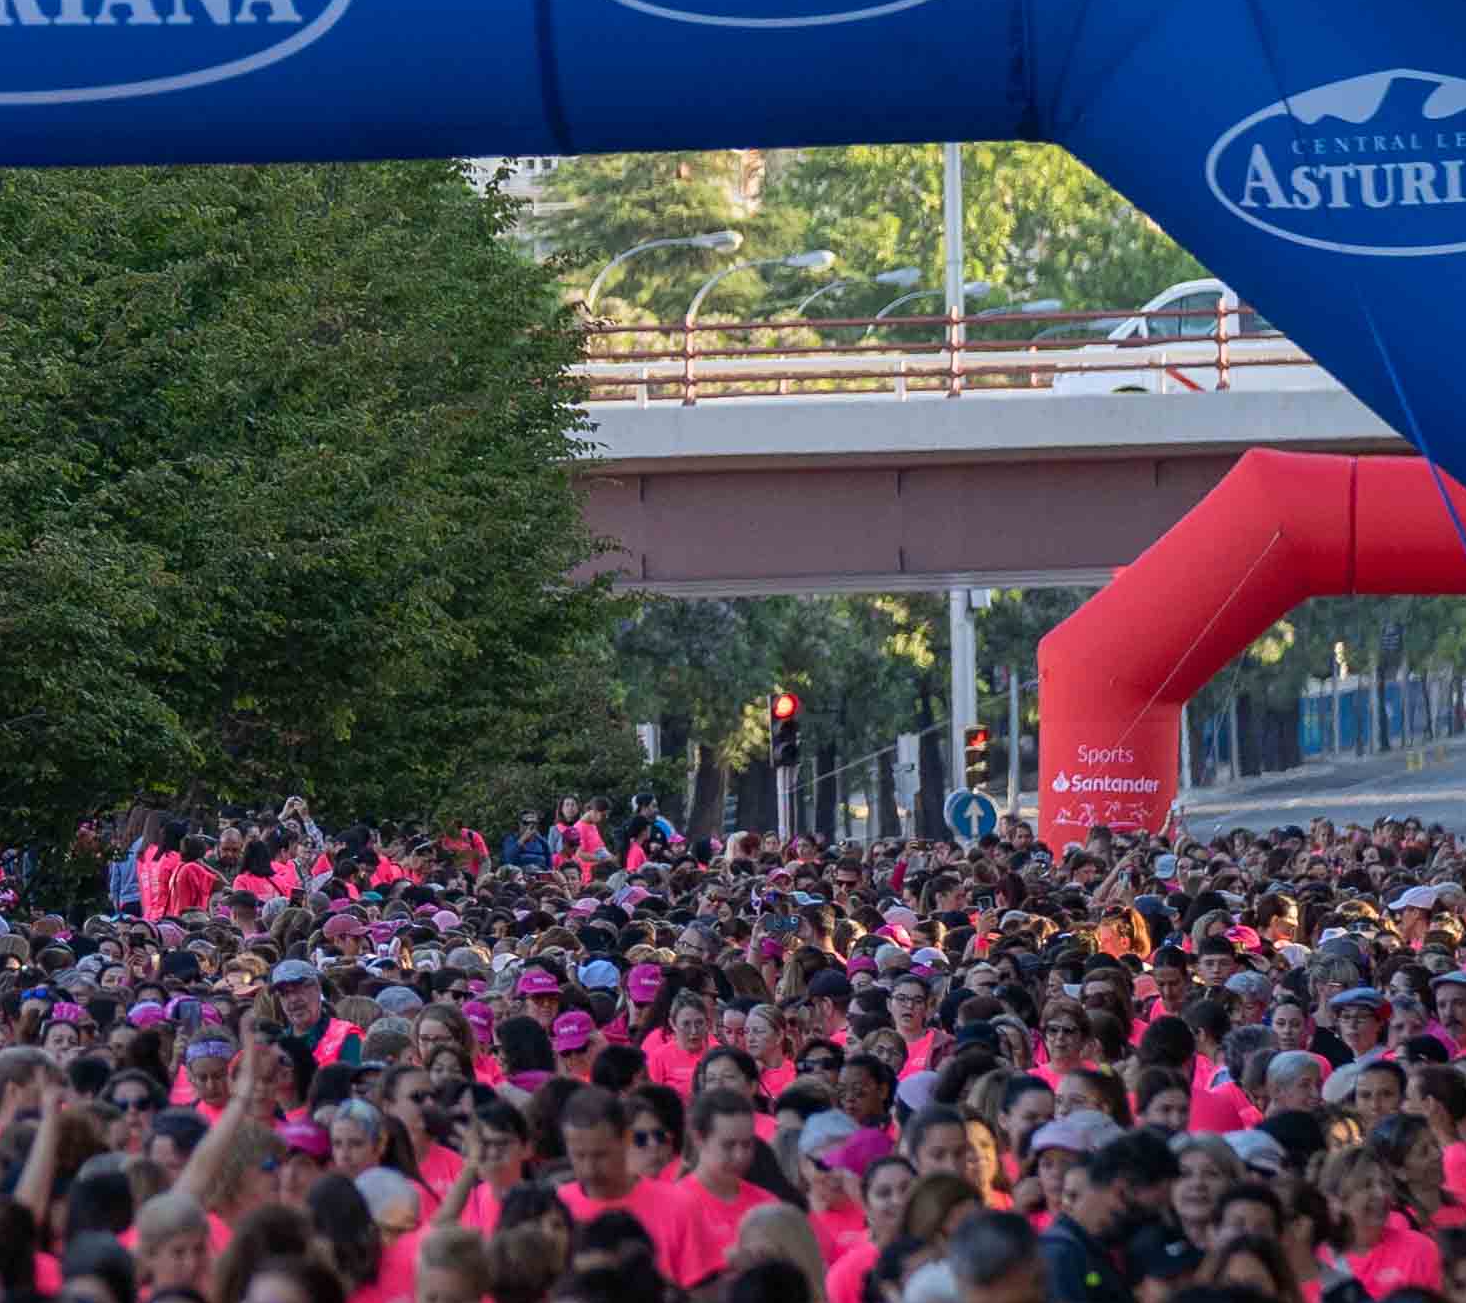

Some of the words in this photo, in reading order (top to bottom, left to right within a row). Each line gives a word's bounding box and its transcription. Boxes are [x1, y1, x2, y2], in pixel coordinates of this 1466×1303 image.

[1291, 134, 1422, 155] CENTRAL
[1077, 744, 1135, 766] Sports
[1071, 775, 1159, 793] Santander
